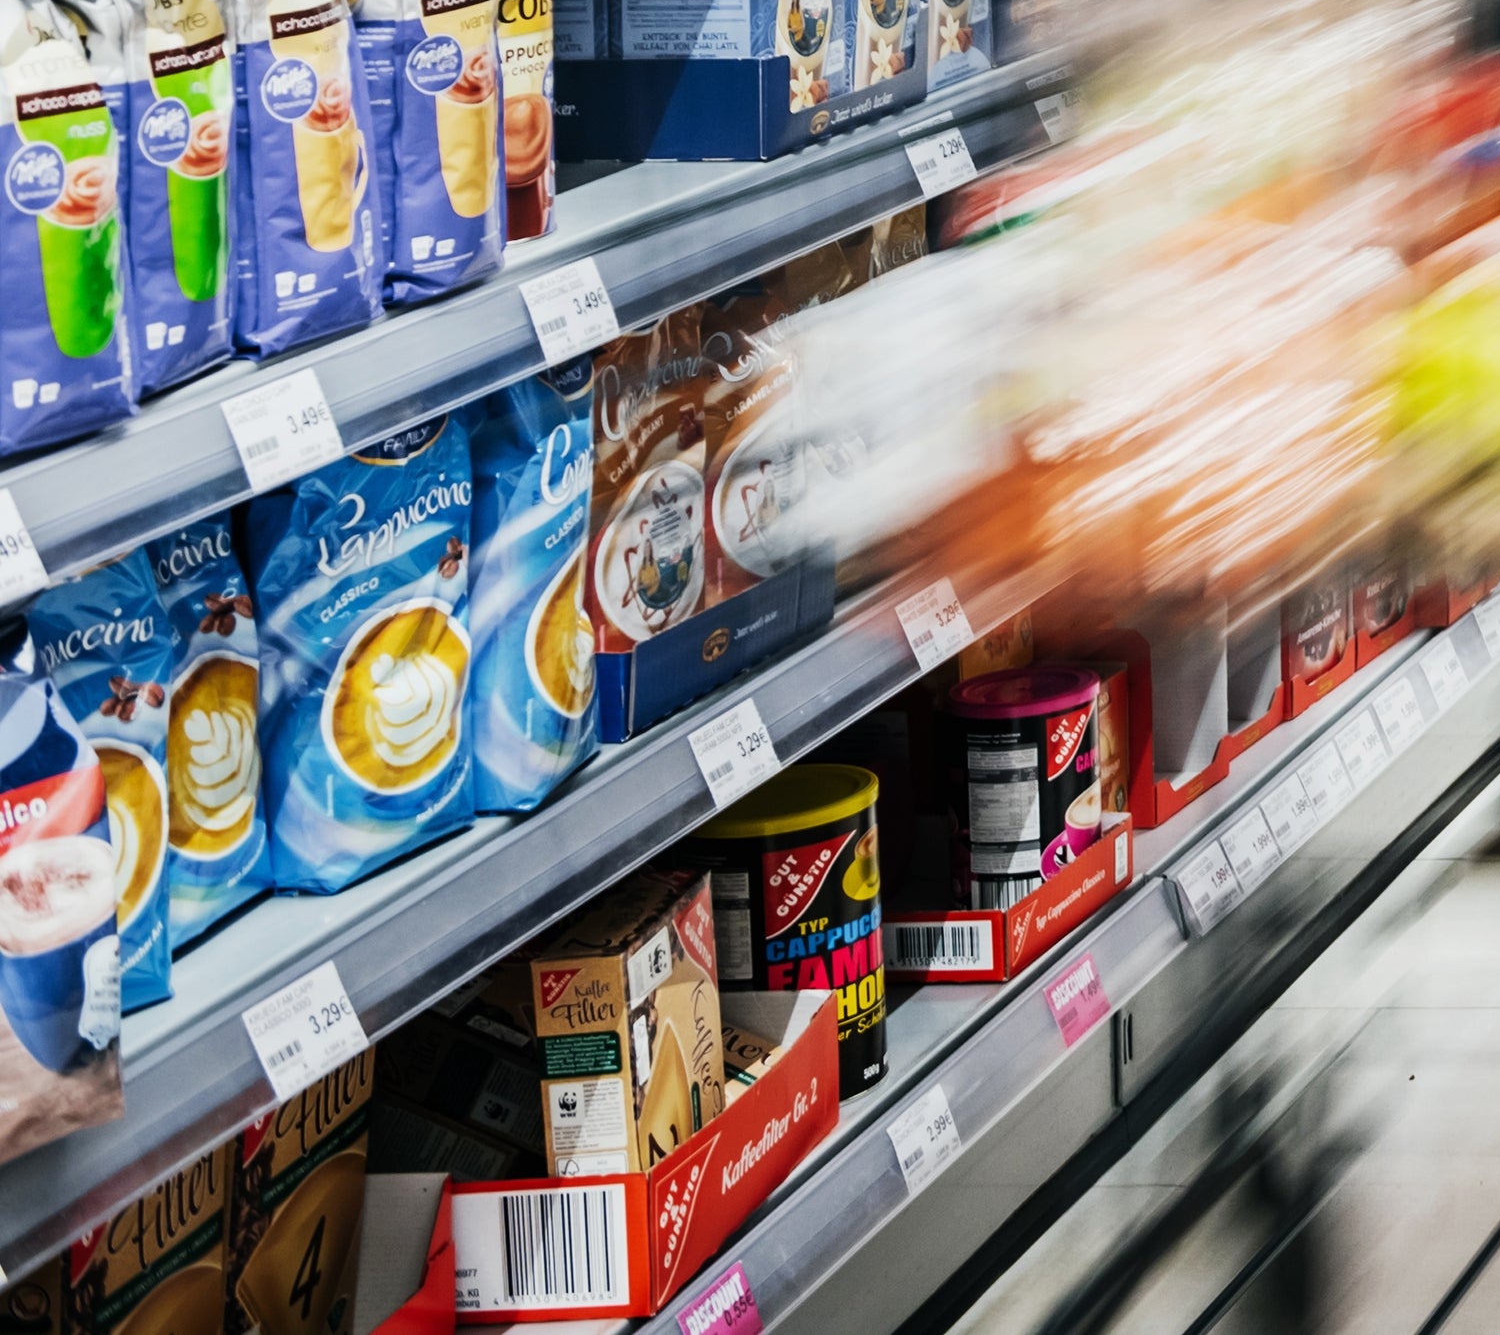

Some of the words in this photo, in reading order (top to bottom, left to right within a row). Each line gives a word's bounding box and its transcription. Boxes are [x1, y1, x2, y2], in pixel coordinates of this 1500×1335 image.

[701, 32, 728, 41] BUNTE
[716, 42, 738, 51] LATTE
[511, 64, 545, 77] CHOCO
[939, 136, 964, 159] 2,29€
[576, 290, 607, 314] 3,49€
[287, 405, 331, 434] 3,49€
[318, 480, 471, 577] Cappuccino
[320, 577, 379, 623] CLASSICO
[935, 602, 961, 627] 3,29€
[737, 728, 768, 757] 3,29€
[1051, 718, 1070, 743] GUT
[1055, 714, 1087, 765] GÜNSTIG
[1252, 833, 1271, 855] 1,99€
[769, 854, 798, 887] GUT
[776, 849, 831, 917] GÜNSTIG
[788, 873, 801, 885] &
[1210, 864, 1231, 889] 1,99€
[1046, 886, 1083, 924] Cappuccino
[1082, 869, 1107, 896] Classico
[798, 917, 829, 935] TYP
[574, 980, 610, 1000] Kaffee
[1052, 959, 1096, 1011] DISCOUNT
[310, 997, 352, 1035] 3,29€
[551, 1000, 617, 1028] Filter
[864, 1063, 879, 1080] 500g
[720, 1105, 790, 1196] Kaffeefilter
[791, 1090, 809, 1124] Gr.
[808, 1079, 818, 1104] 2
[926, 1112, 952, 1142] 2,99€
[107, 1151, 215, 1270] Filter
[660, 1180, 679, 1229] GUT
[663, 1164, 700, 1269] GÜNSTIG
[290, 1215, 326, 1320] 4
[686, 1271, 745, 1334] DISCOUNT
[724, 1288, 755, 1328] 0,55€
